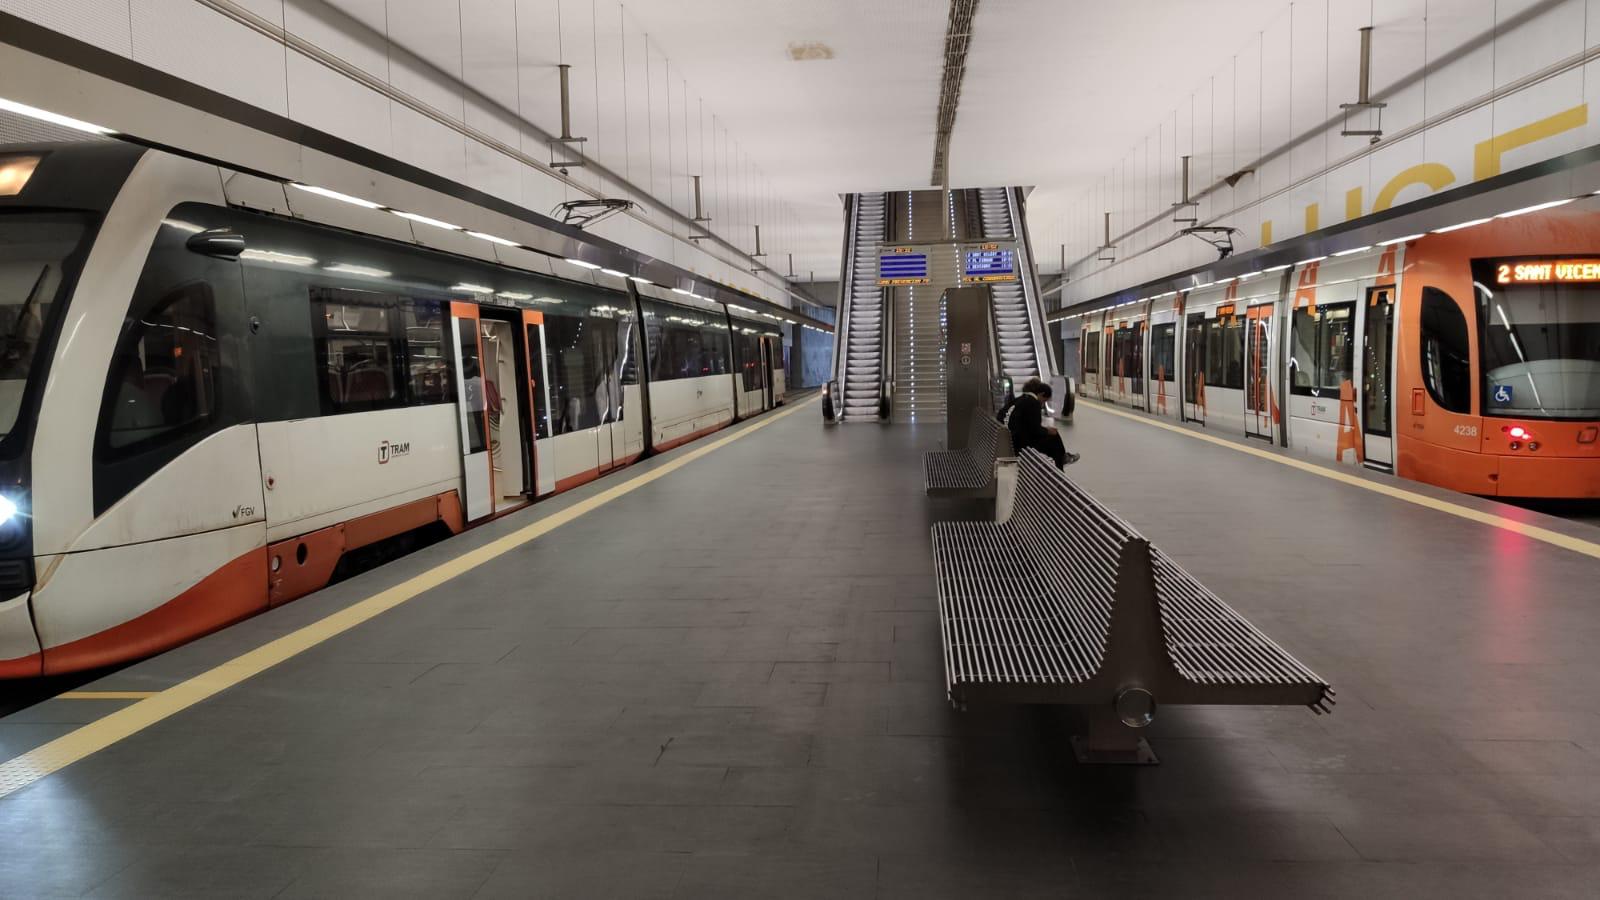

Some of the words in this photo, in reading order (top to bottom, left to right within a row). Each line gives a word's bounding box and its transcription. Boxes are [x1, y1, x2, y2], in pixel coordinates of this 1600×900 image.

[1497, 264, 1511, 284] 2
[1514, 264, 1552, 281] SANT
[1453, 425, 1478, 437] 4238
[390, 442, 410, 455] TRAM
[240, 505, 255, 518] FGV
